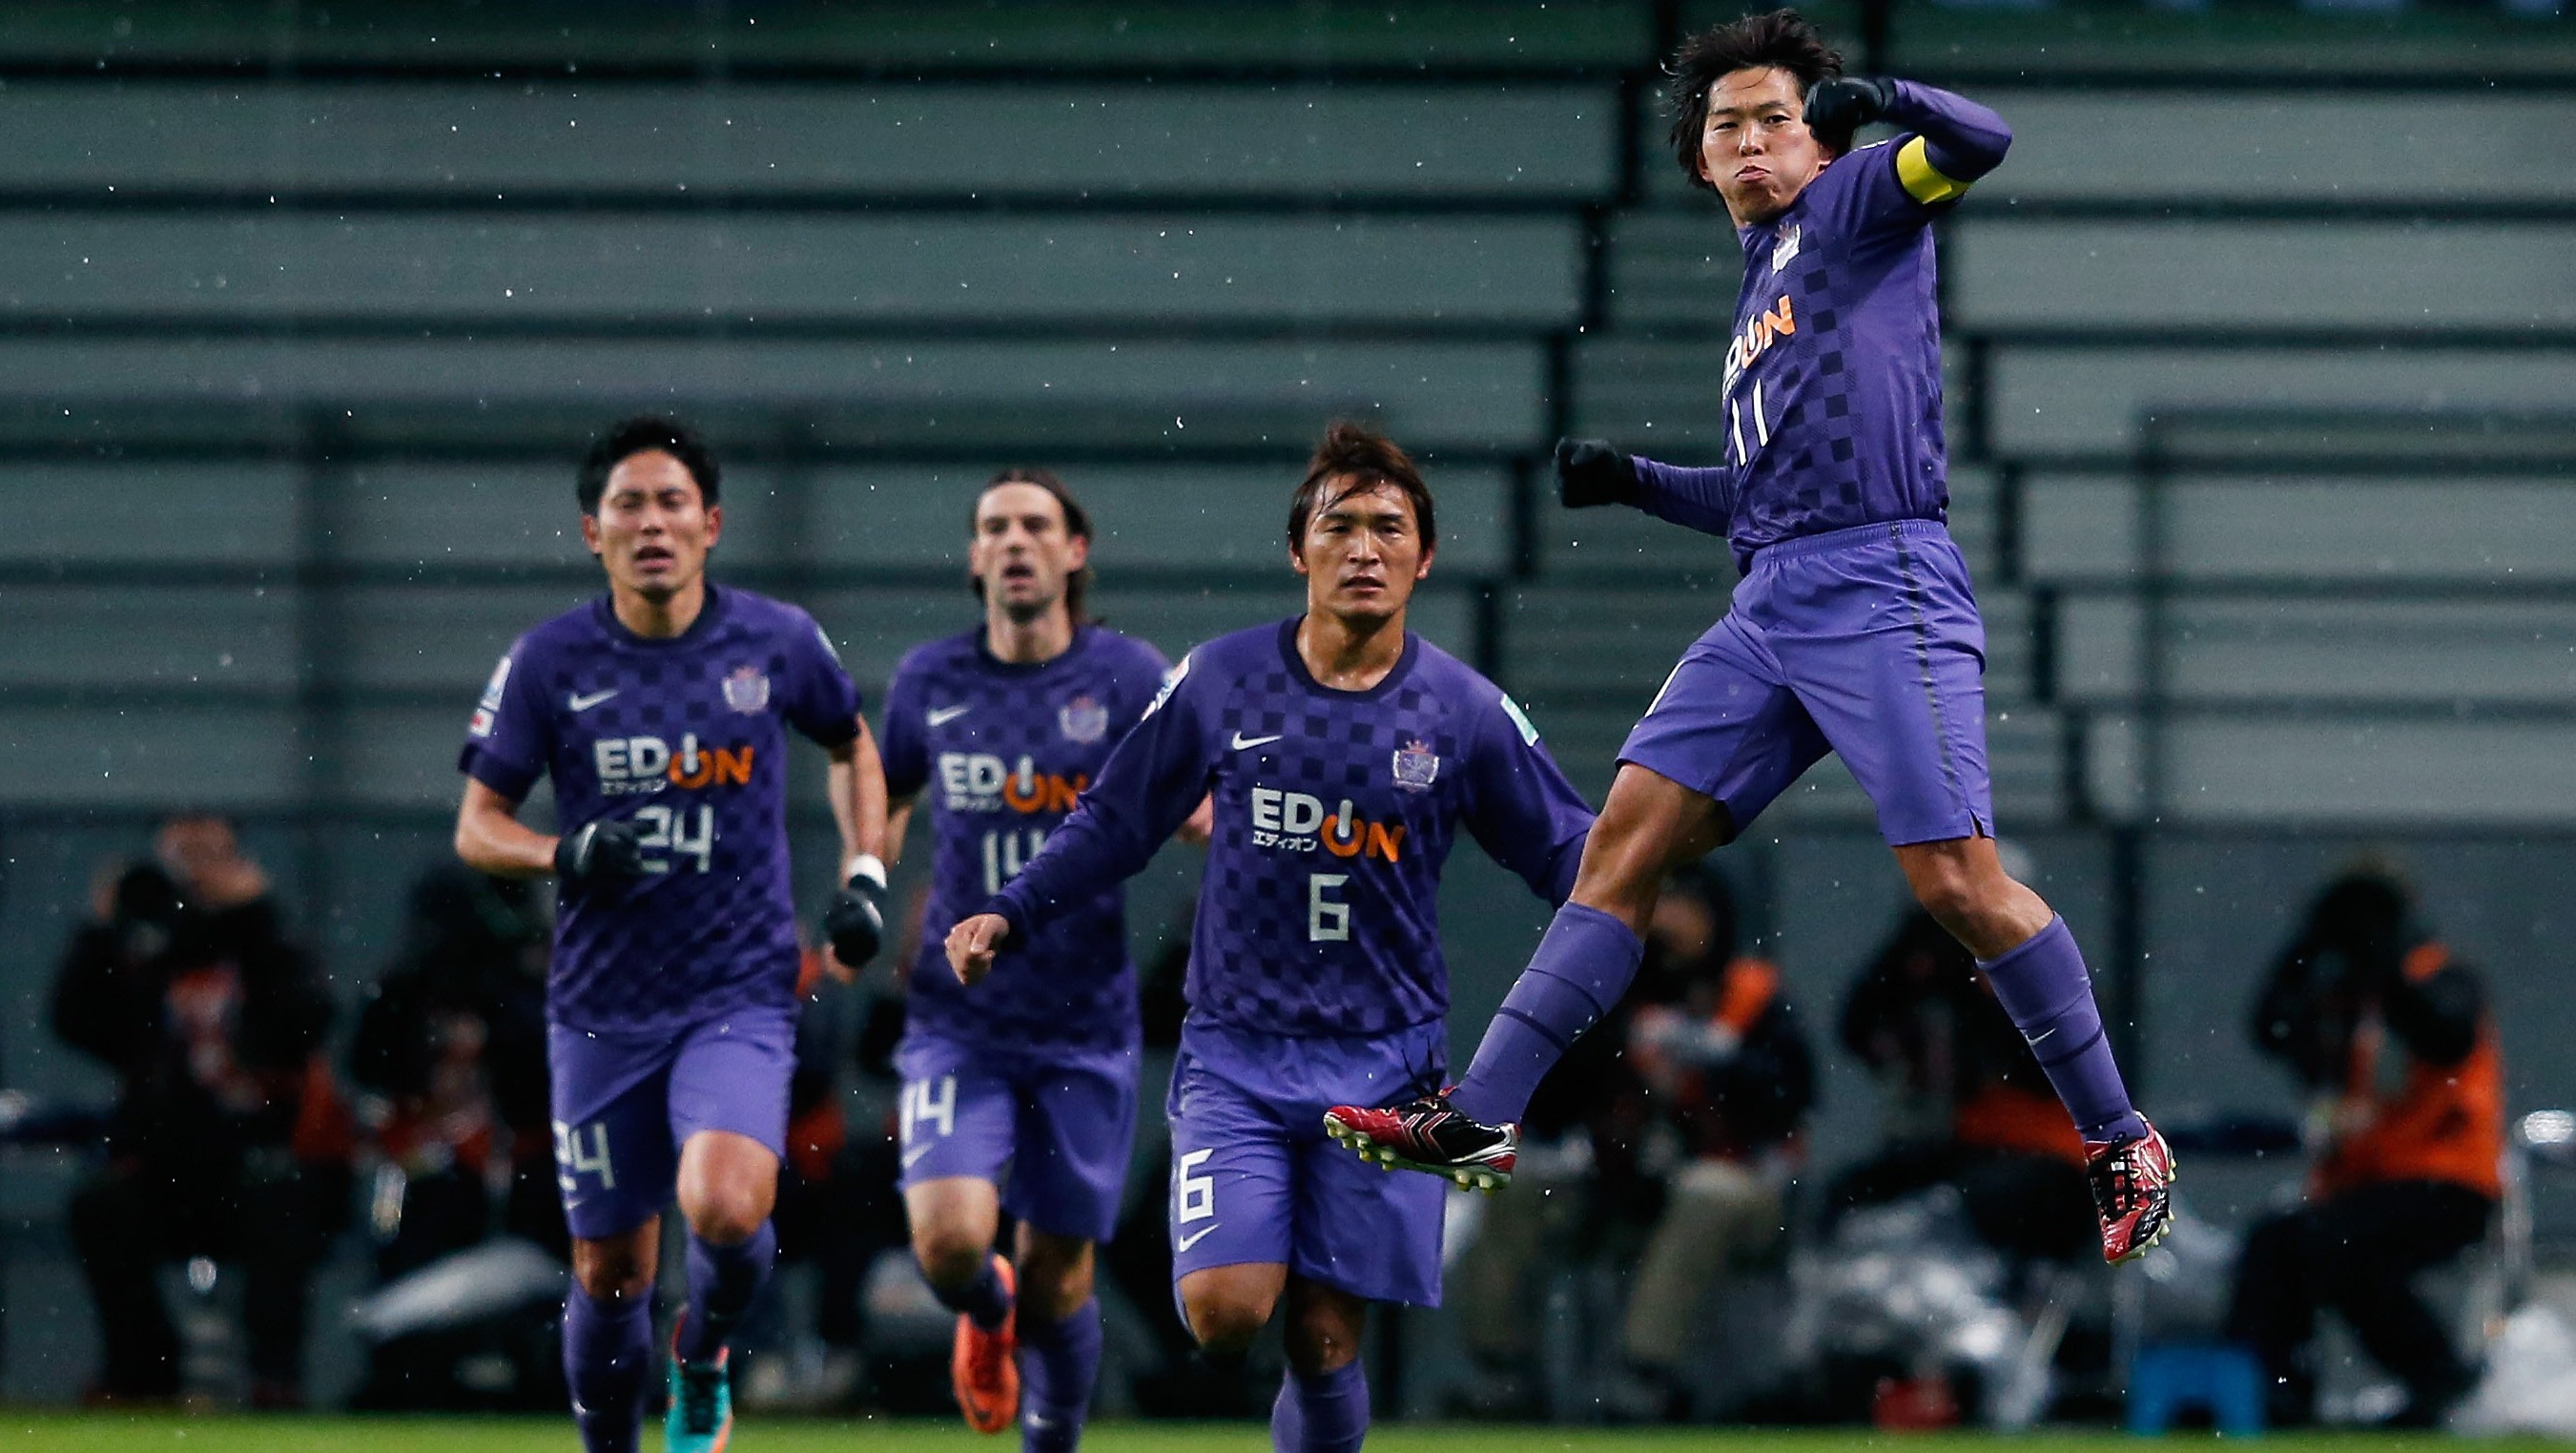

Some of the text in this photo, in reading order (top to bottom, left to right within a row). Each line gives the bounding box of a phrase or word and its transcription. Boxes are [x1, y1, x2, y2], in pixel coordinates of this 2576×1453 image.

[1731, 378, 1769, 467] 11
[594, 732, 754, 791] EDION
[633, 803, 715, 874] 24
[1251, 787, 1407, 863] EDION
[1309, 873, 1350, 942] 6
[898, 1074, 956, 1146] 14
[551, 1119, 616, 1192] 24
[1179, 1148, 1214, 1224] 6
